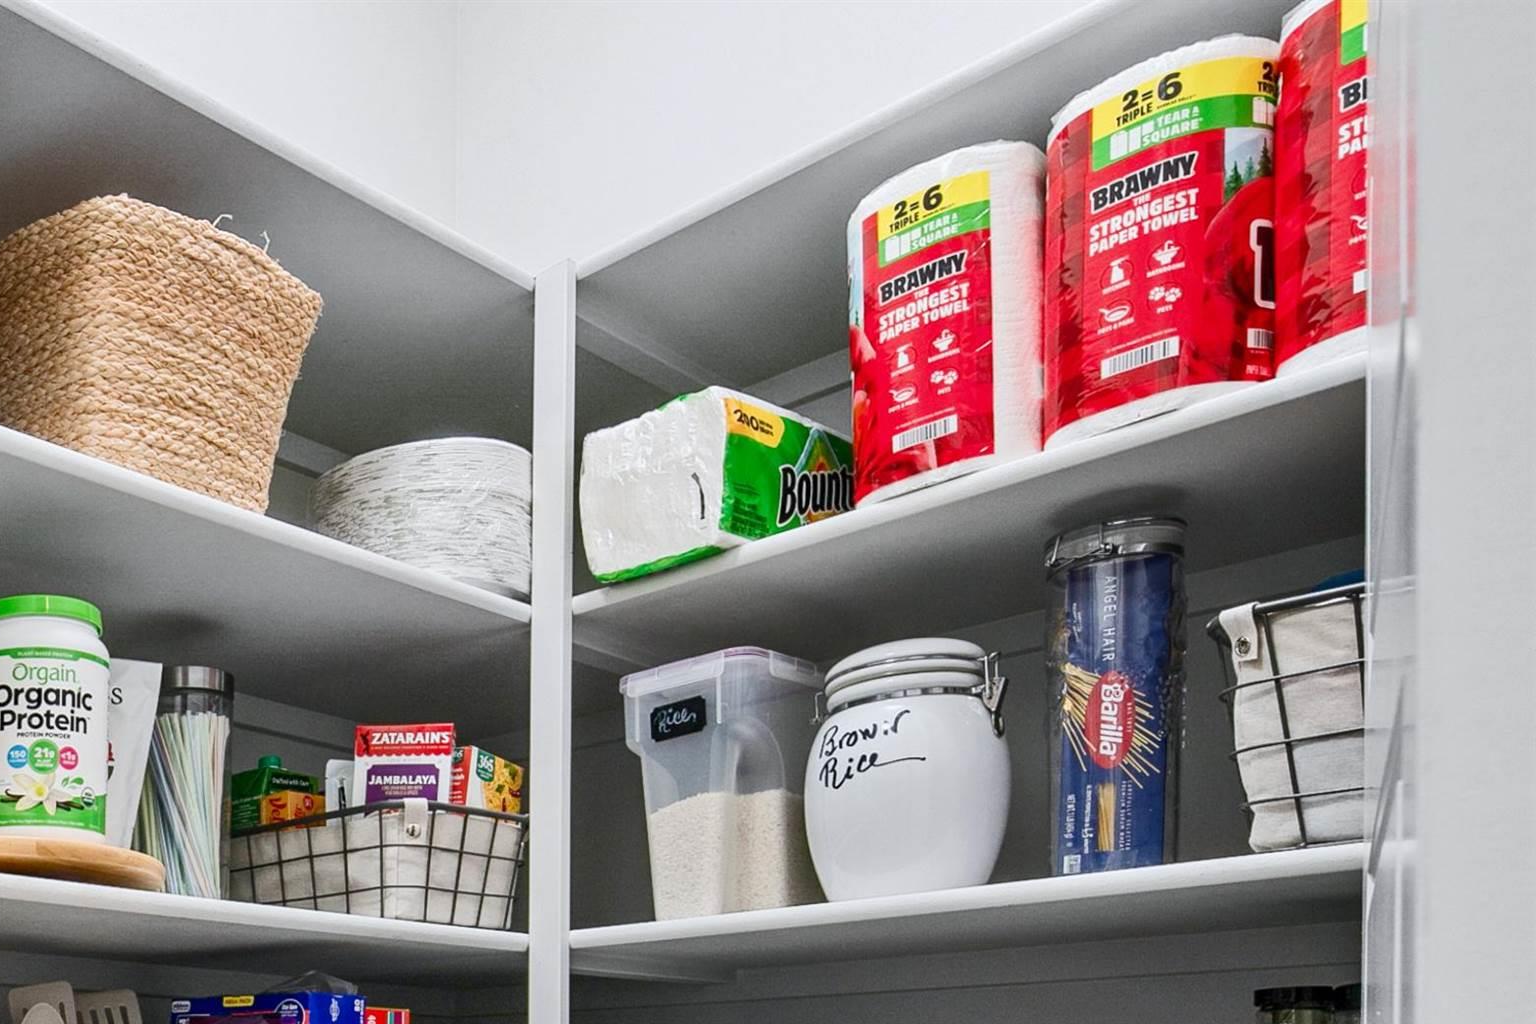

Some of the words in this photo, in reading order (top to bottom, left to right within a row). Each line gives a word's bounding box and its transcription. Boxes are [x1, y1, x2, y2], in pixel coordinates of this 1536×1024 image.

[1116, 102, 1153, 127] TRIPLE
[1156, 107, 1191, 128] TEAR
[1142, 118, 1201, 147] SQUARE
[1092, 153, 1197, 213] BRAWNY
[1132, 193, 1151, 207] THE
[889, 212, 920, 233] TRIPLE
[923, 215, 951, 231] TEAR
[1089, 187, 1199, 243] STRONGEST
[911, 225, 959, 250] SQUARE
[1089, 228, 1140, 258] PAPER
[1143, 205, 1199, 235] TOWEL
[880, 251, 967, 304] BRAWNY
[879, 282, 970, 330] STRONGEST
[914, 286, 930, 300] THE
[879, 318, 921, 345] PAPER
[923, 299, 970, 326] TOWEL
[776, 464, 856, 528] Bount
[1102, 575, 1117, 620] ANGEL
[1101, 627, 1117, 662] HAIR
[12, 662, 77, 685] Orgain
[0, 709, 87, 734] Protein
[1098, 684, 1124, 757] Barilla
[371, 731, 450, 745] ZATARAIN'S
[477, 754, 494, 772] 365
[819, 751, 927, 790] Rice
[368, 774, 437, 785] JAMBALAYA
